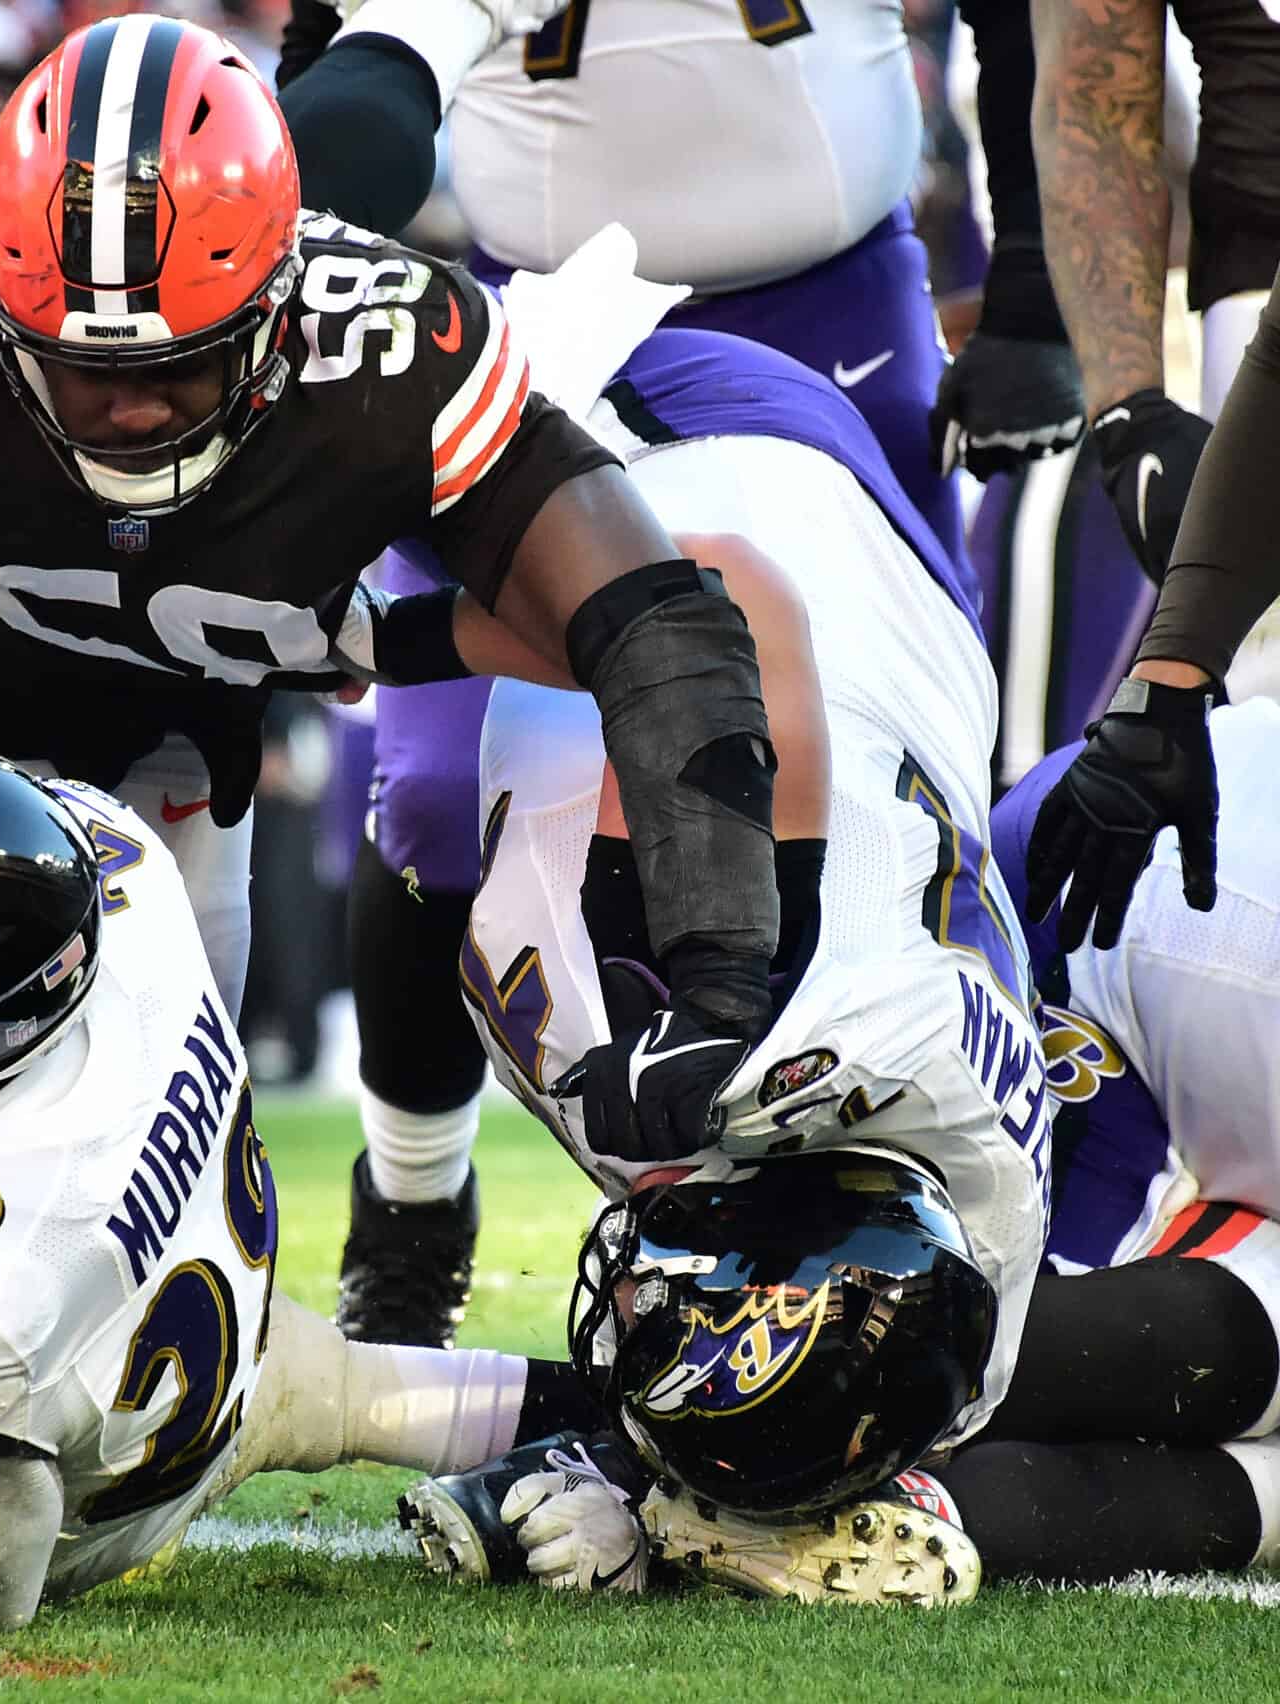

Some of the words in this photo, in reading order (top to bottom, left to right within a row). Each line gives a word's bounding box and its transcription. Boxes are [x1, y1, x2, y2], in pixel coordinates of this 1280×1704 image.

[85, 324, 138, 338] BROWNS
[298, 254, 433, 383] 58
[106, 991, 237, 1289] MURRAY
